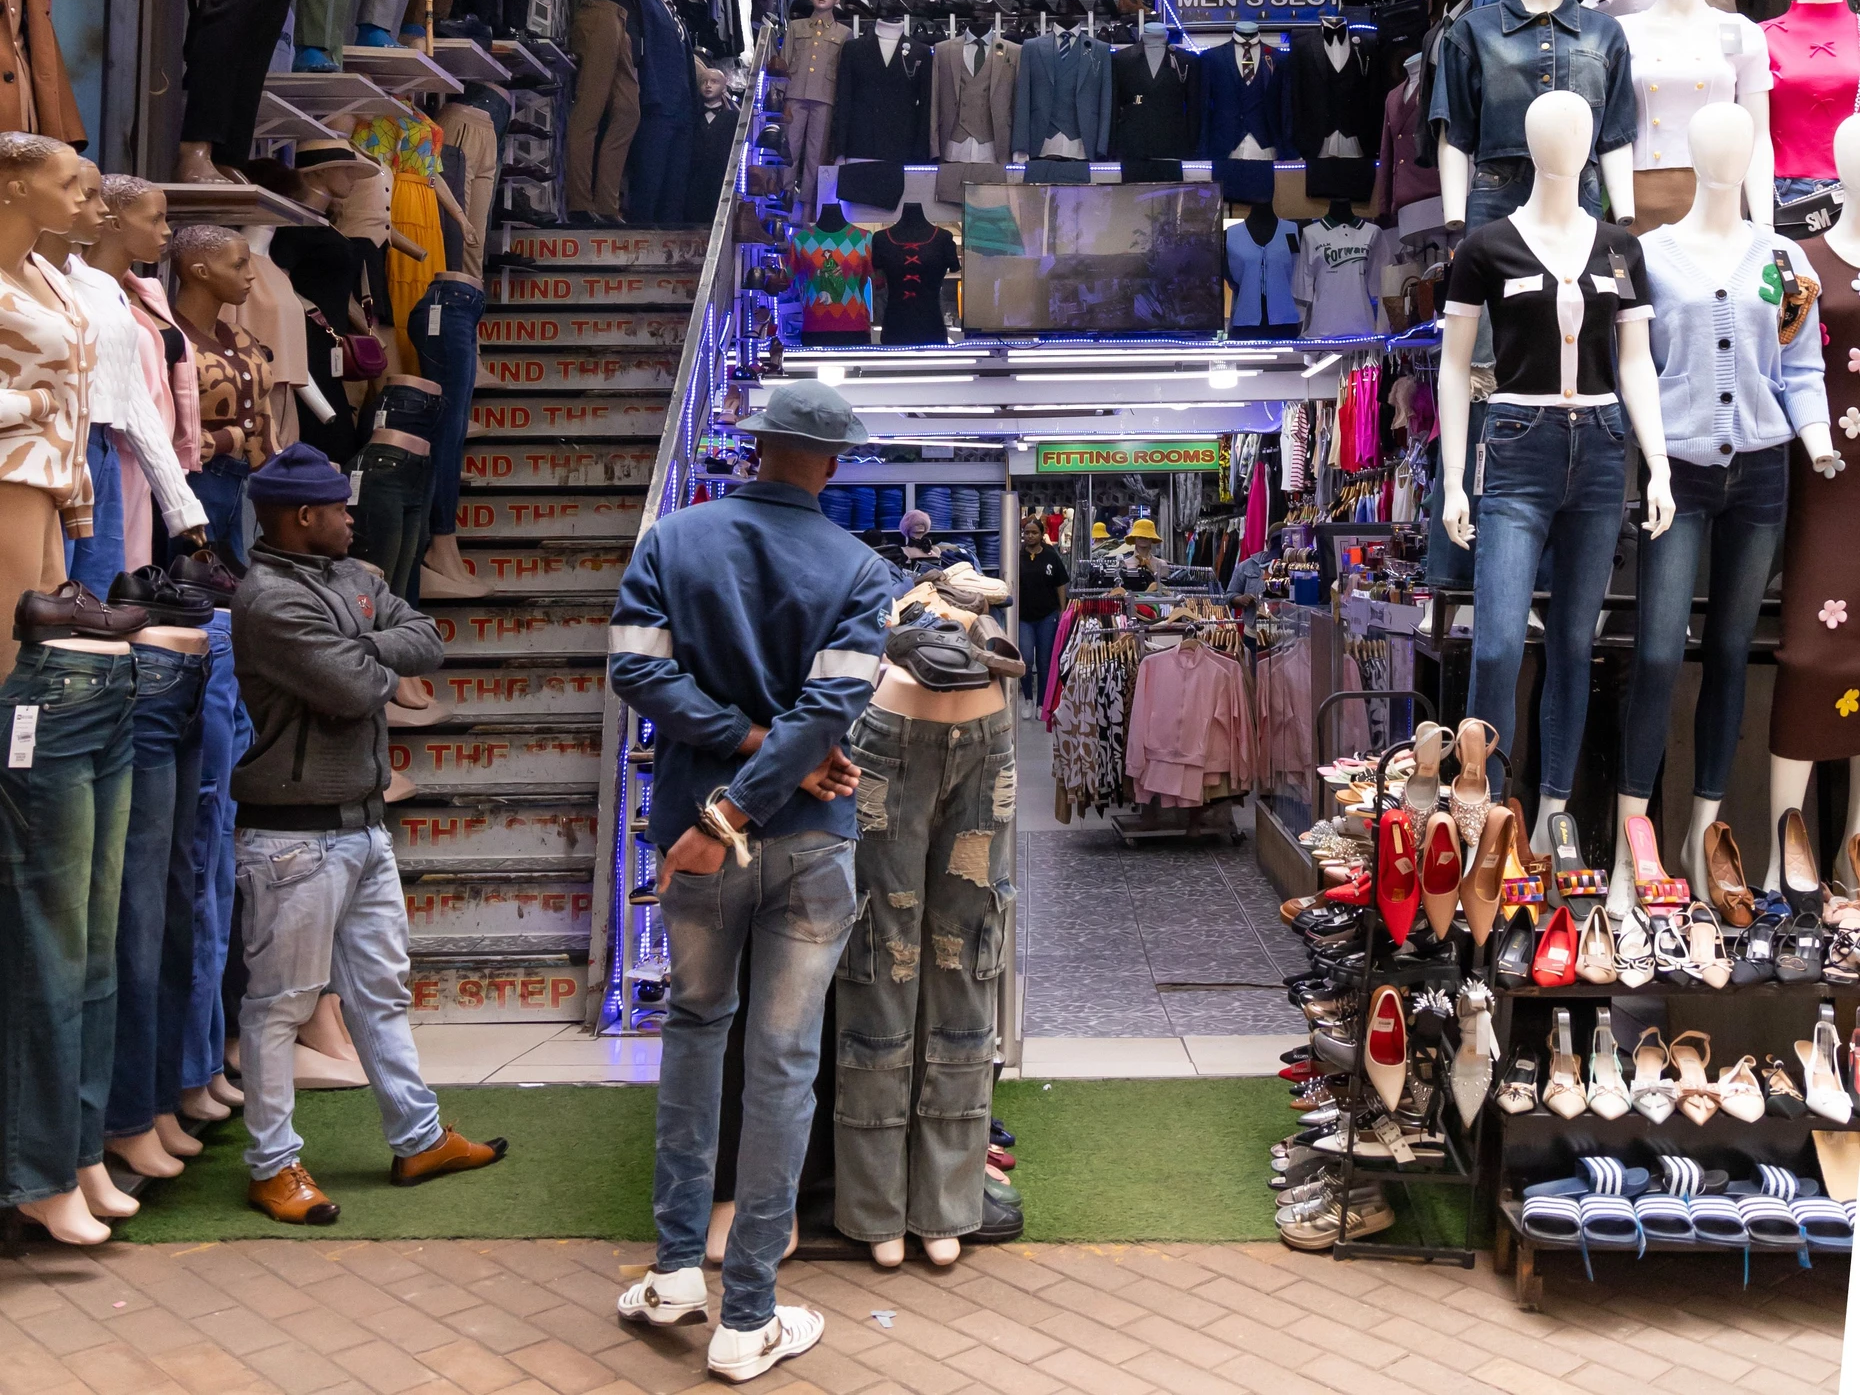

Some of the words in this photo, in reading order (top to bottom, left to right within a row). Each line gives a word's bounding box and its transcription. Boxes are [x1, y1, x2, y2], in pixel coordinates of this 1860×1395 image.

[1805, 207, 1831, 232] SM
[478, 320, 560, 343] MIND
[1042, 450, 1129, 465] FITTING
[1133, 449, 1216, 465] ROOMS
[457, 977, 578, 1010] STEP
